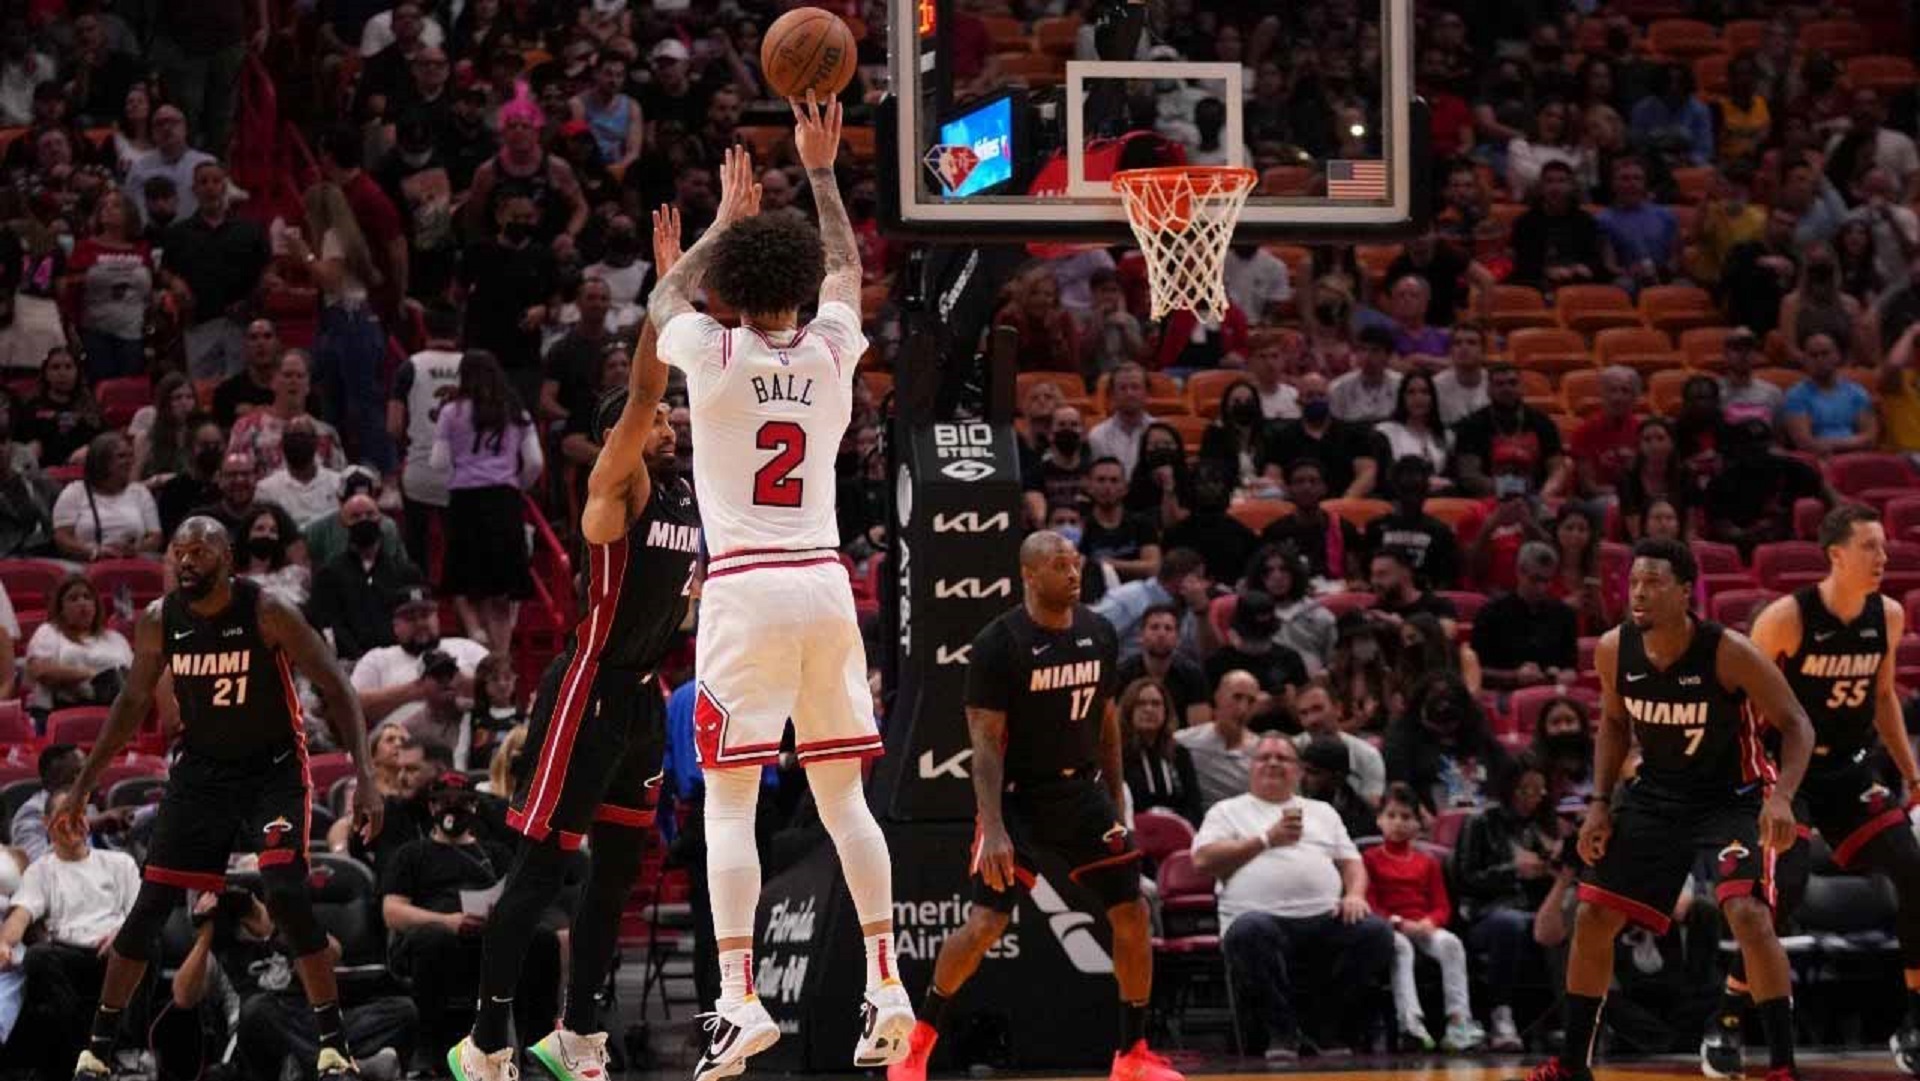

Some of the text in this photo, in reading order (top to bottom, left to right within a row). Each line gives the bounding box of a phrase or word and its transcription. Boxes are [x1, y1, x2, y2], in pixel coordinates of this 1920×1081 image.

[752, 373, 812, 406] BALL
[935, 424, 993, 446] BIO
[753, 421, 806, 507] 2
[646, 521, 701, 552] MIAM
[933, 512, 1009, 532] KIA
[900, 537, 911, 656] AT&T
[935, 577, 1011, 598] KIA
[172, 650, 250, 676] MIAMI
[1031, 659, 1101, 692] MIAMI
[1801, 652, 1881, 678] MIAMI
[213, 676, 247, 706] 21
[1070, 686, 1096, 720] 17
[1826, 678, 1870, 708] 55
[1624, 696, 1708, 725] MIAMI
[1684, 727, 1705, 755] 7
